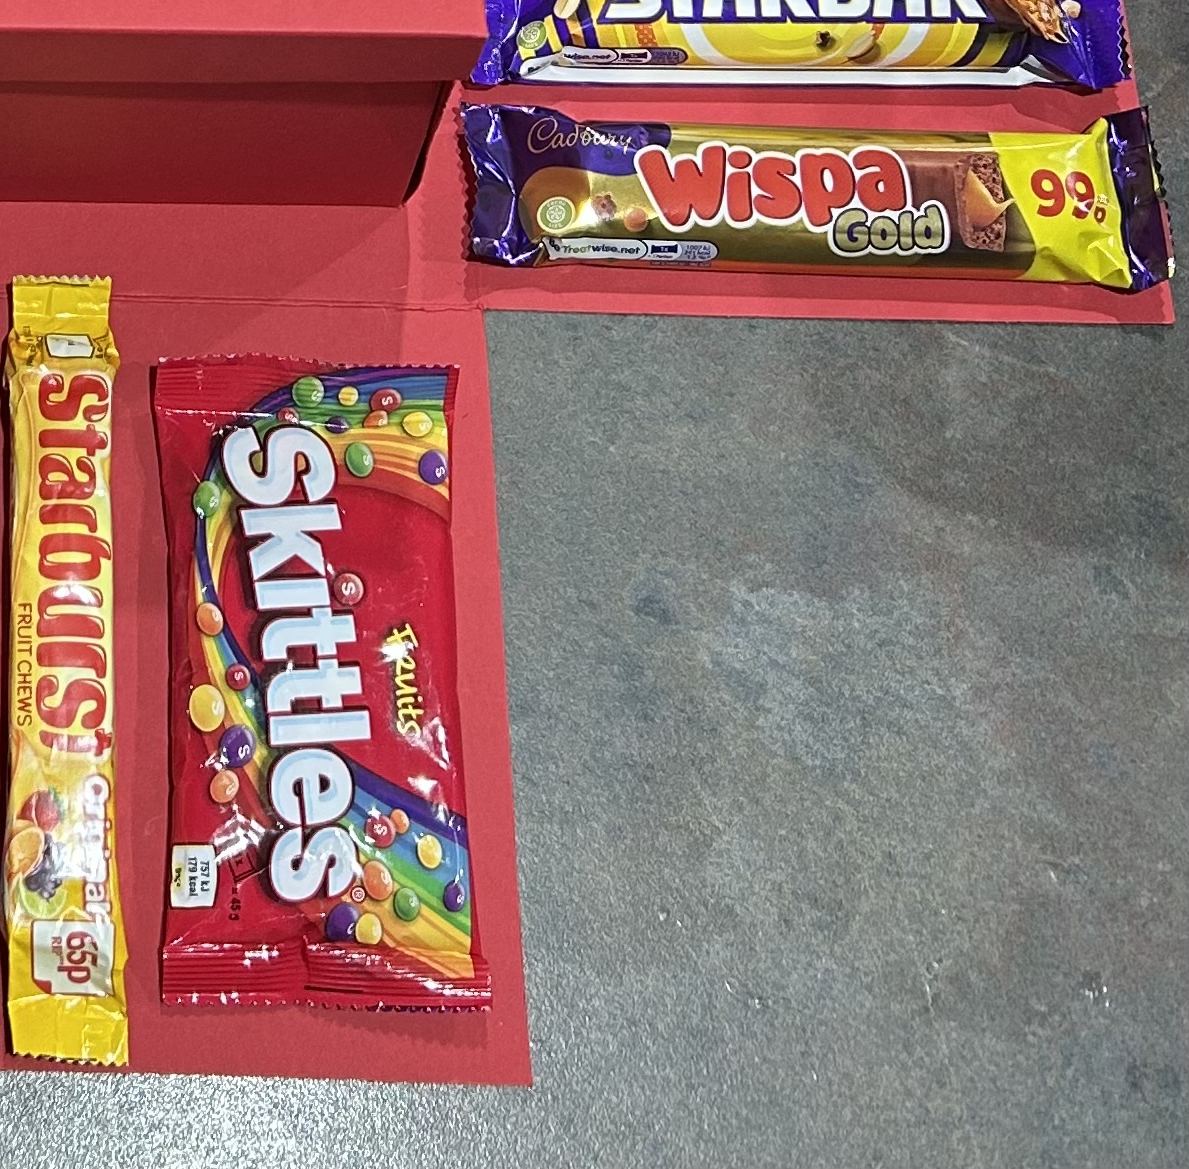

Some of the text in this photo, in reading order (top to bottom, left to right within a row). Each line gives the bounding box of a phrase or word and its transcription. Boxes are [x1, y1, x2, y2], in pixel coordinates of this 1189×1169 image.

[527, 116, 633, 155] Cadbury
[637, 143, 909, 229] Wispa
[562, 242, 641, 255] Treatwise.net
[833, 205, 947, 252] Gold
[36, 373, 111, 757] Starburst
[17, 602, 33, 727] FRUIT CHEWS
[223, 426, 370, 901] Skittles
[57, 930, 99, 984] 65p
